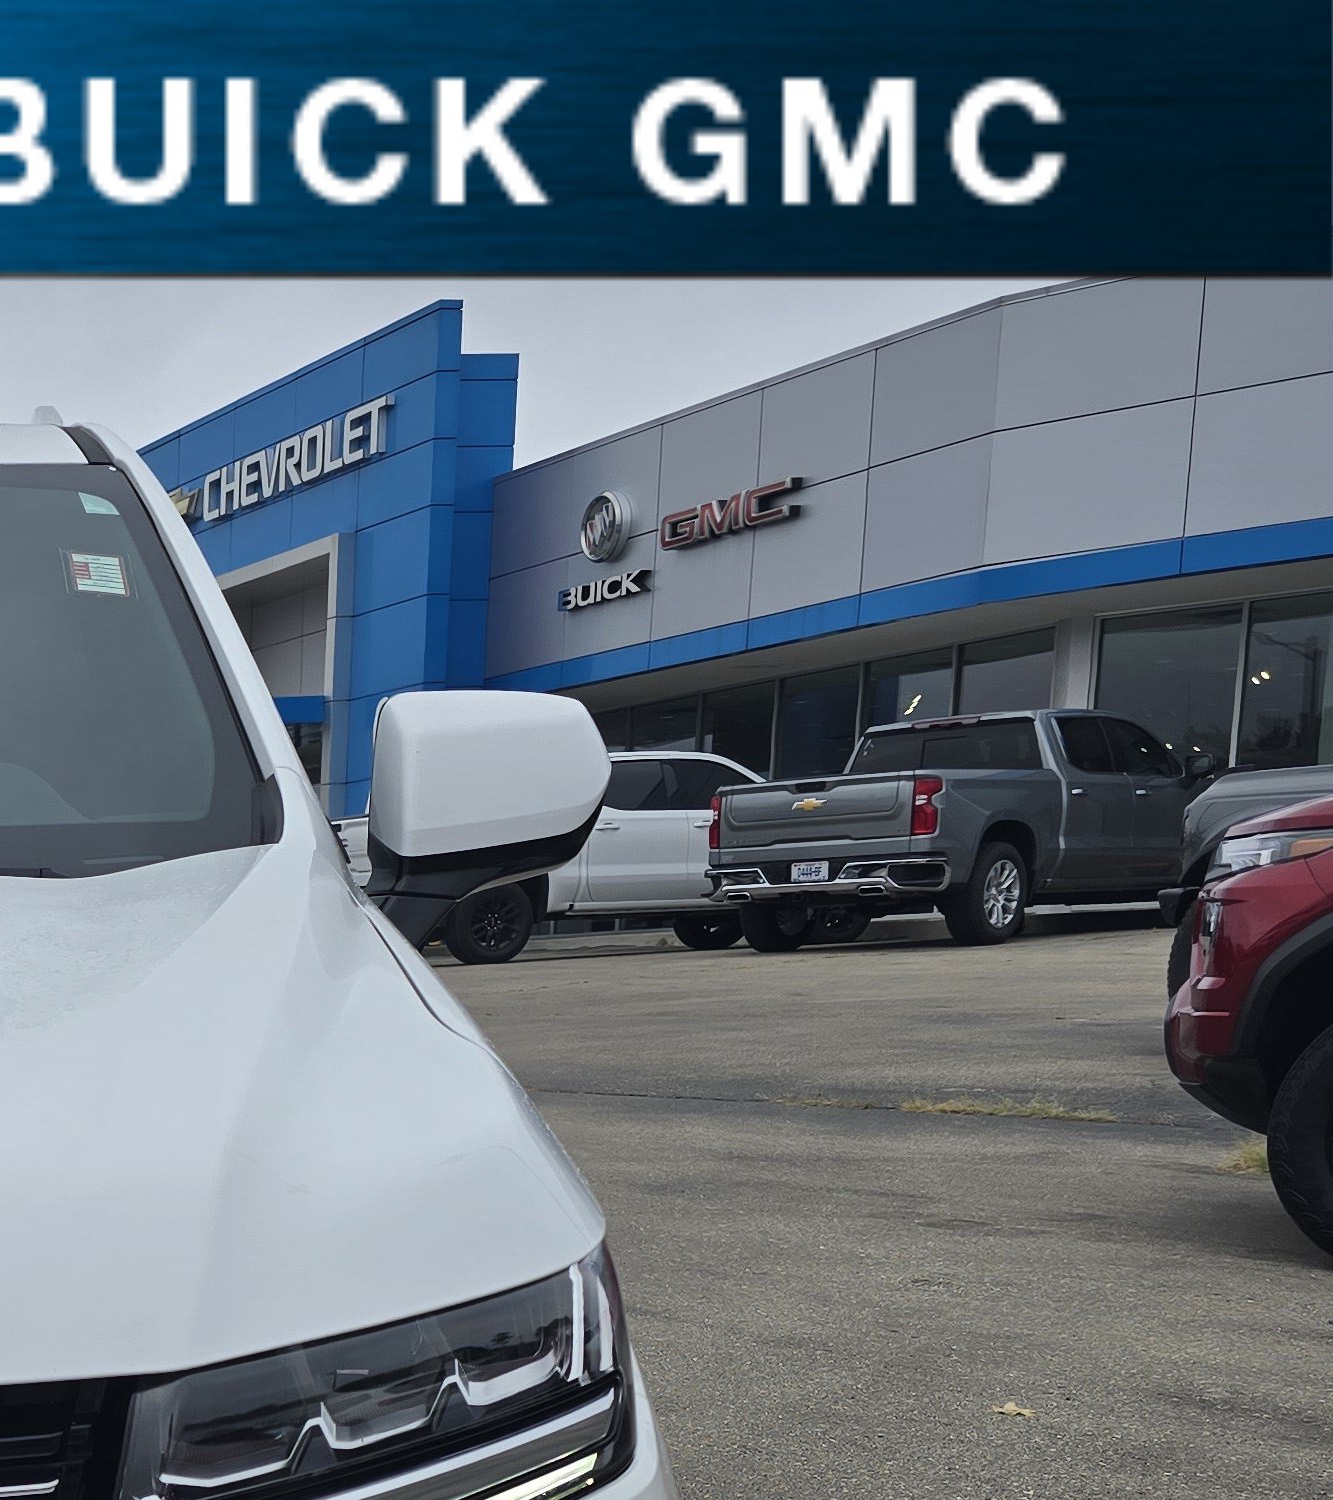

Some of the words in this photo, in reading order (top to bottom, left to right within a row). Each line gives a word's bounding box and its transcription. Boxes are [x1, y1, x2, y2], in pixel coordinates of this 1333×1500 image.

[203, 395, 393, 522] CHEVROLET
[660, 477, 802, 550] GMC
[558, 569, 651, 612] BUICK
